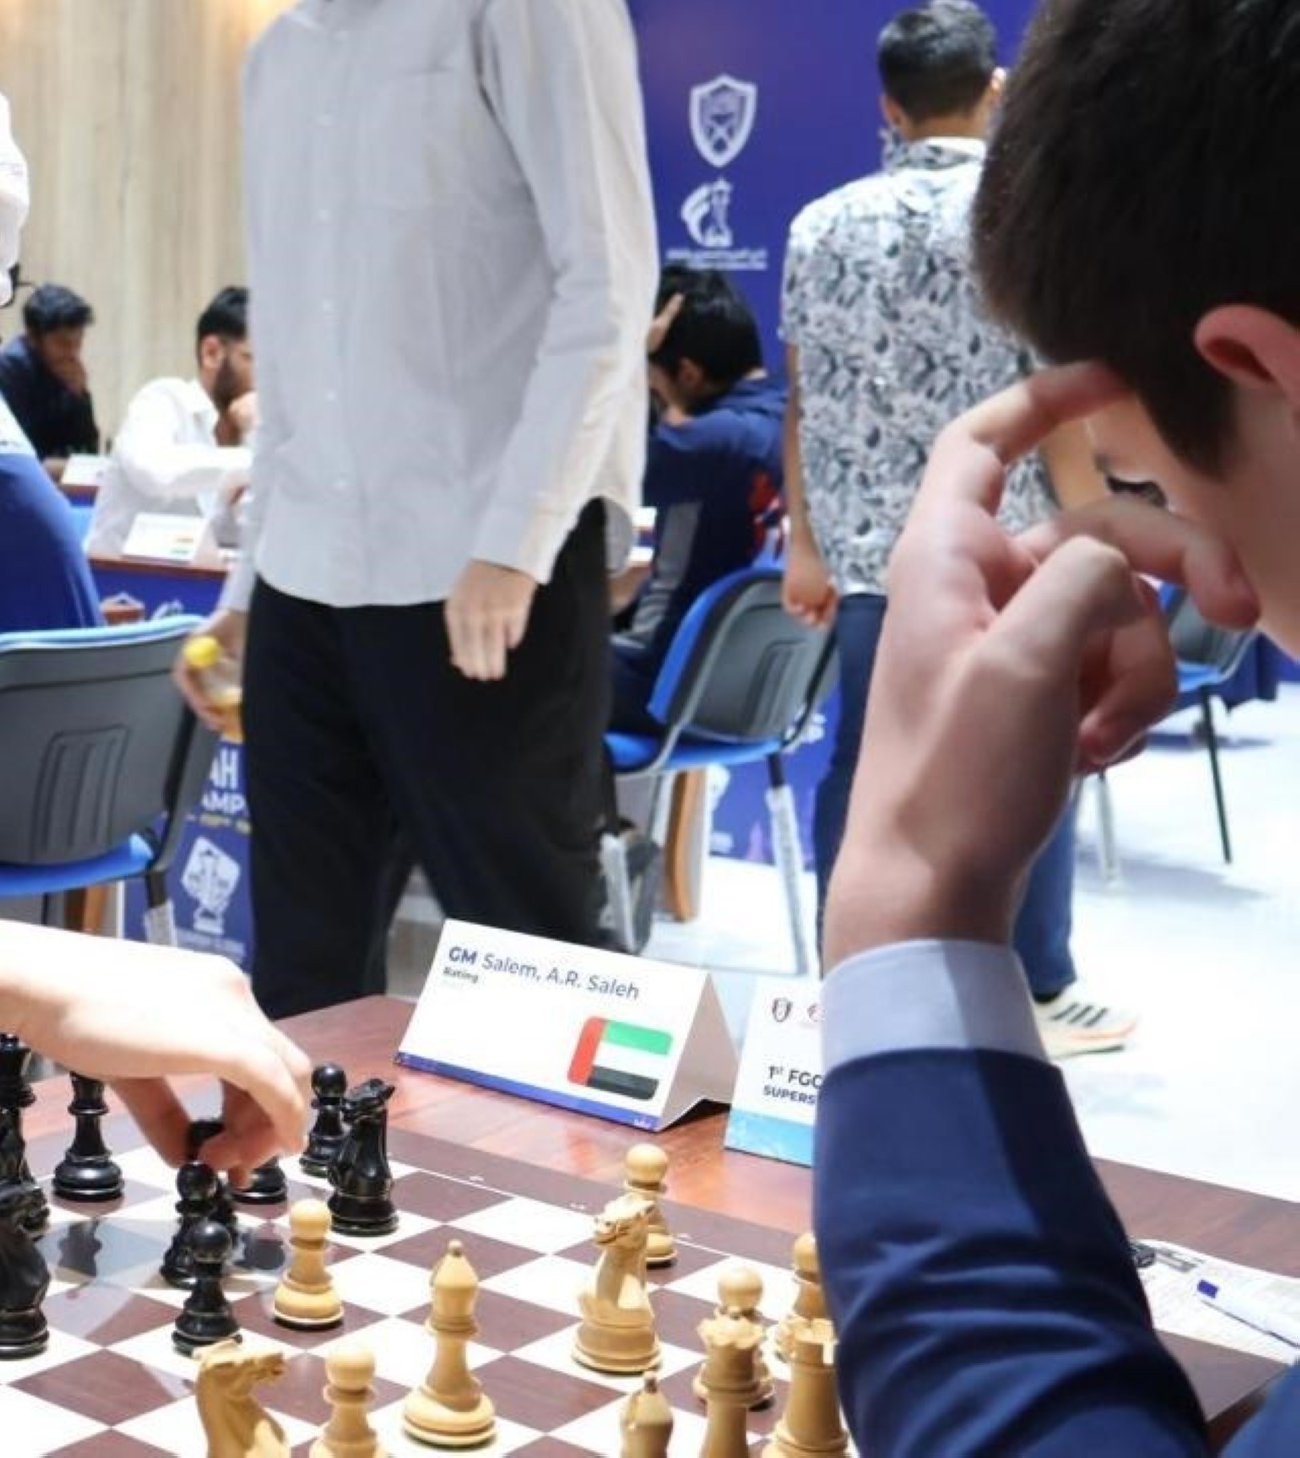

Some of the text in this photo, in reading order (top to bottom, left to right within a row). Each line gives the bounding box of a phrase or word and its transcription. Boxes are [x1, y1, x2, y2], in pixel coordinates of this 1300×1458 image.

[448, 946, 641, 1000] GM Salem, A.R. Saleh
